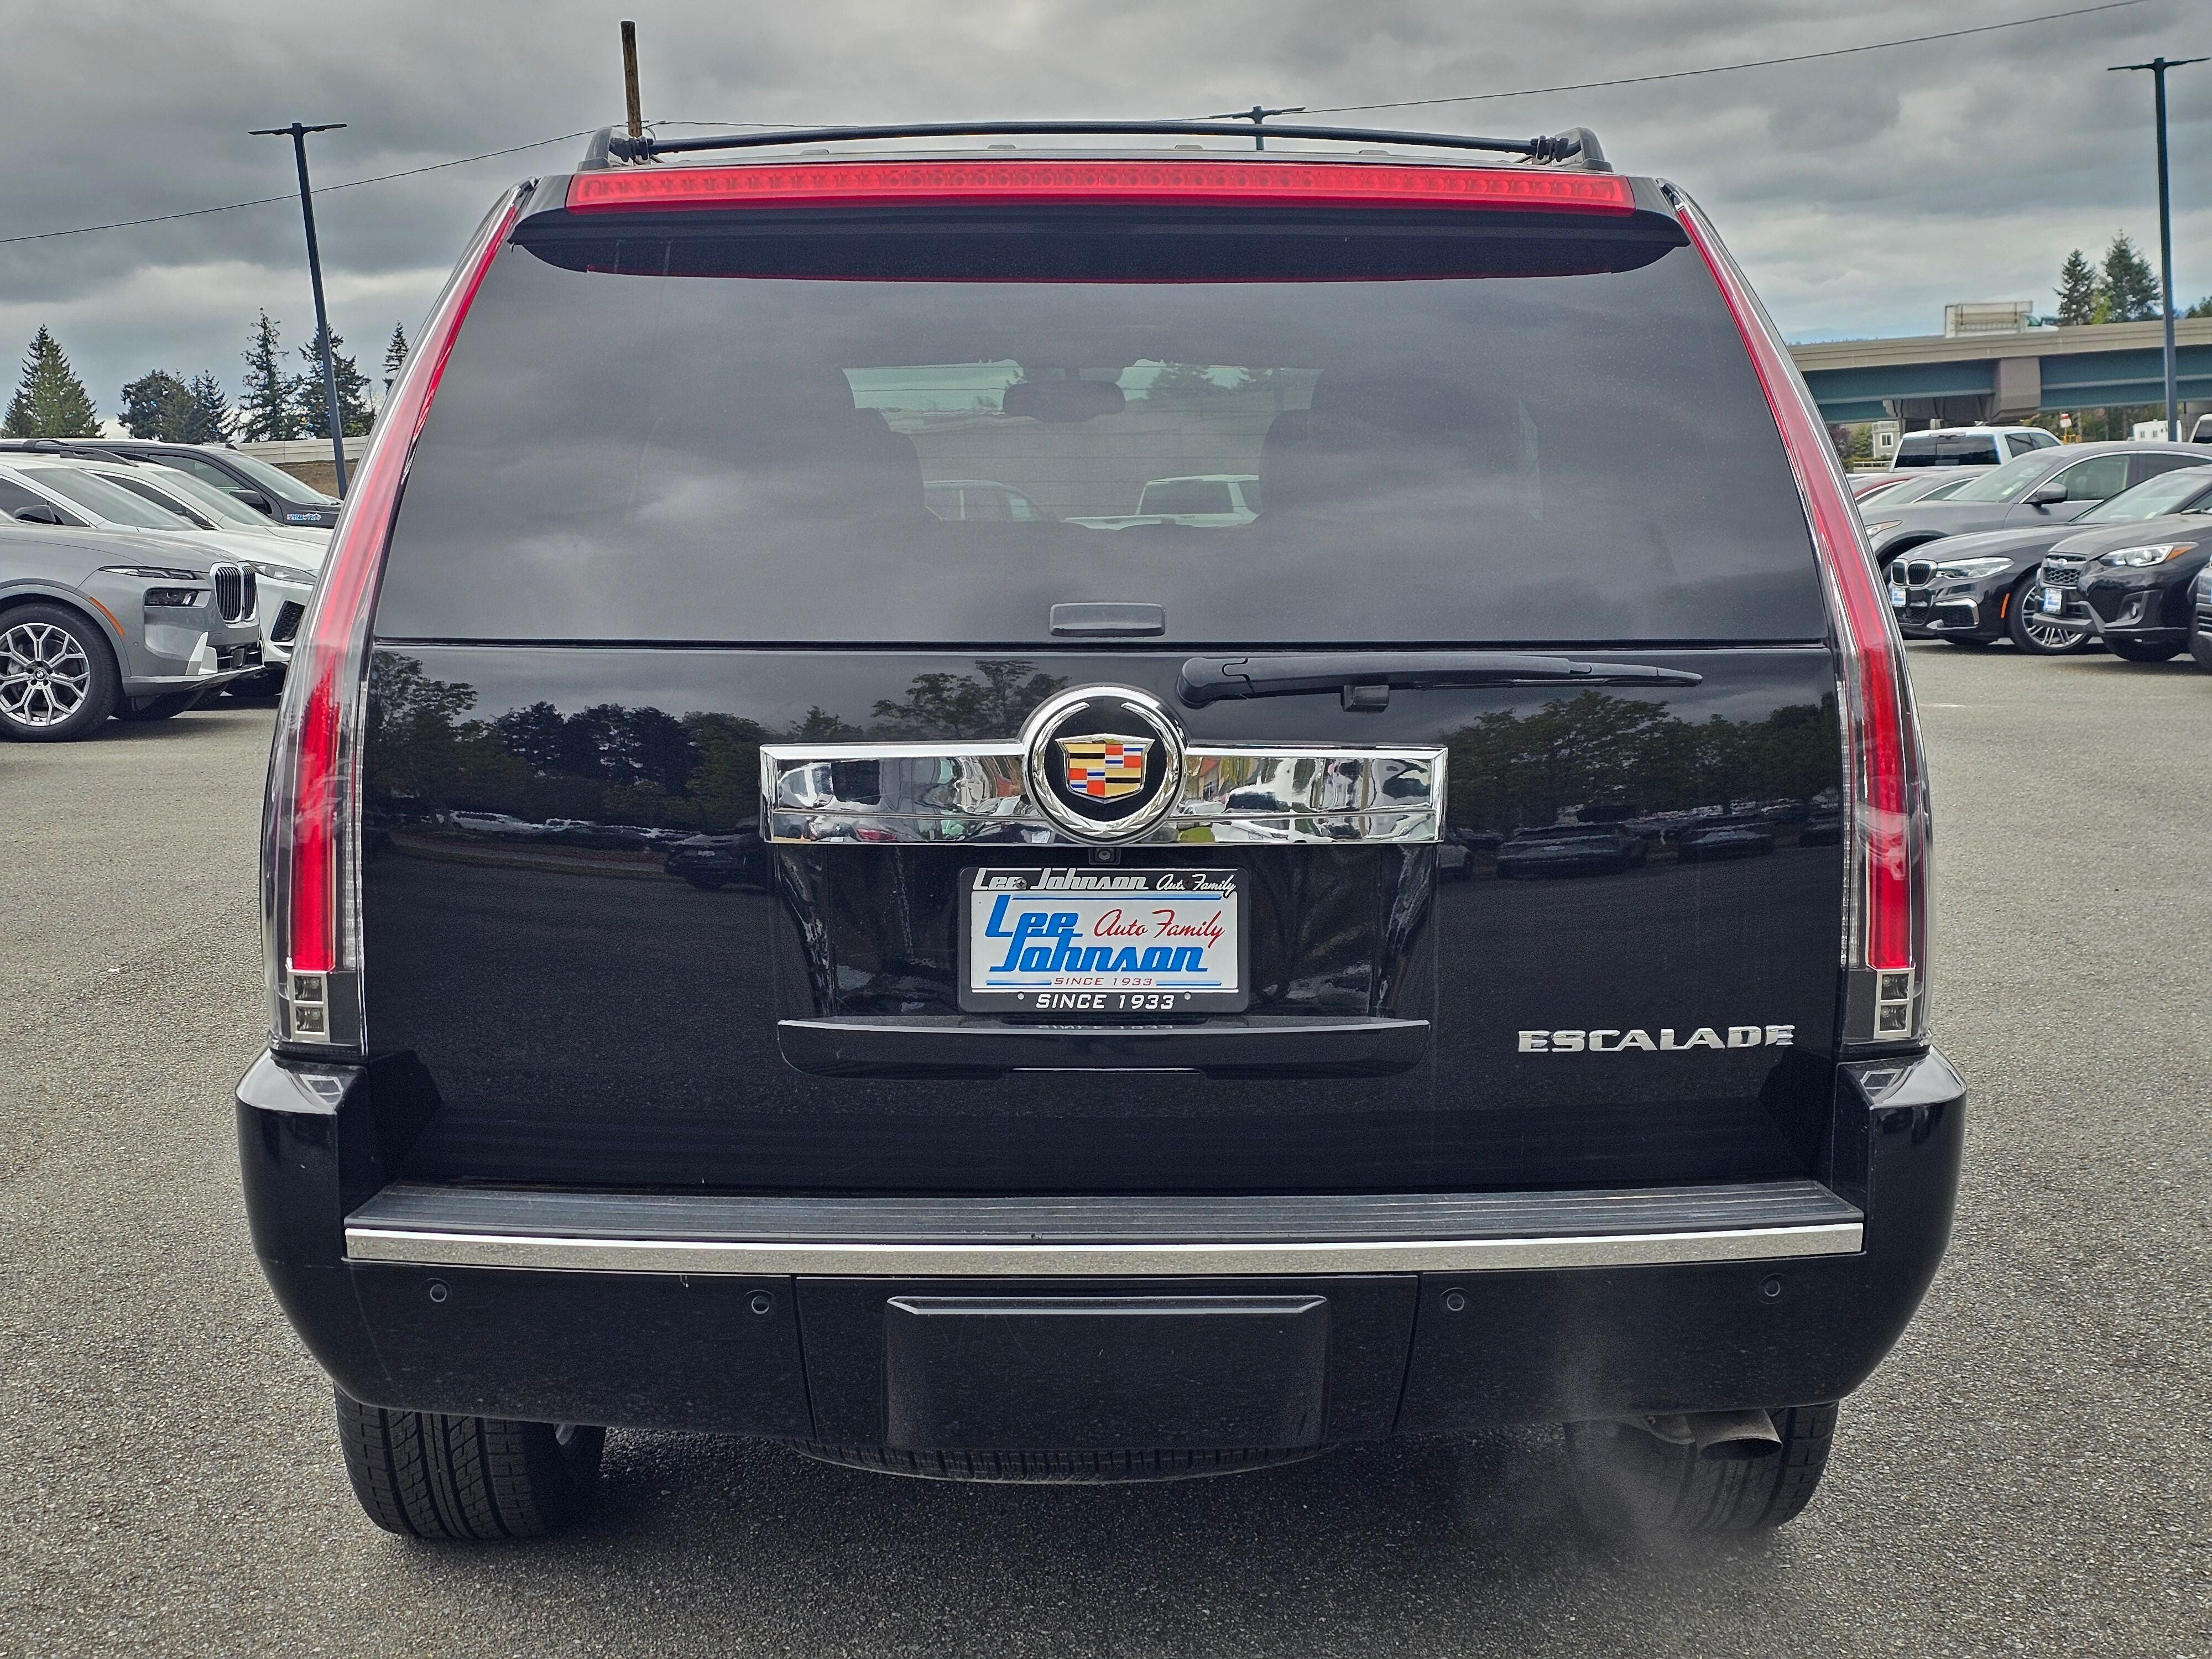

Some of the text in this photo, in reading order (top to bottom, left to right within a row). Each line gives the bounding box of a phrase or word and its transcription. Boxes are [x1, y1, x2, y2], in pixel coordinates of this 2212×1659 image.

[1030, 868, 1149, 890] Johnson
[1156, 874, 1188, 891] Aut
[1191, 873, 1236, 898] Family
[985, 894, 1083, 937] Lee
[1094, 909, 1225, 948] Auto Family
[989, 930, 1208, 972] Johnson
[1054, 977, 1153, 986] SINCE 1933
[1036, 994, 1175, 1009] SINCE 1933
[1517, 1024, 1796, 1052] ESCALADE
